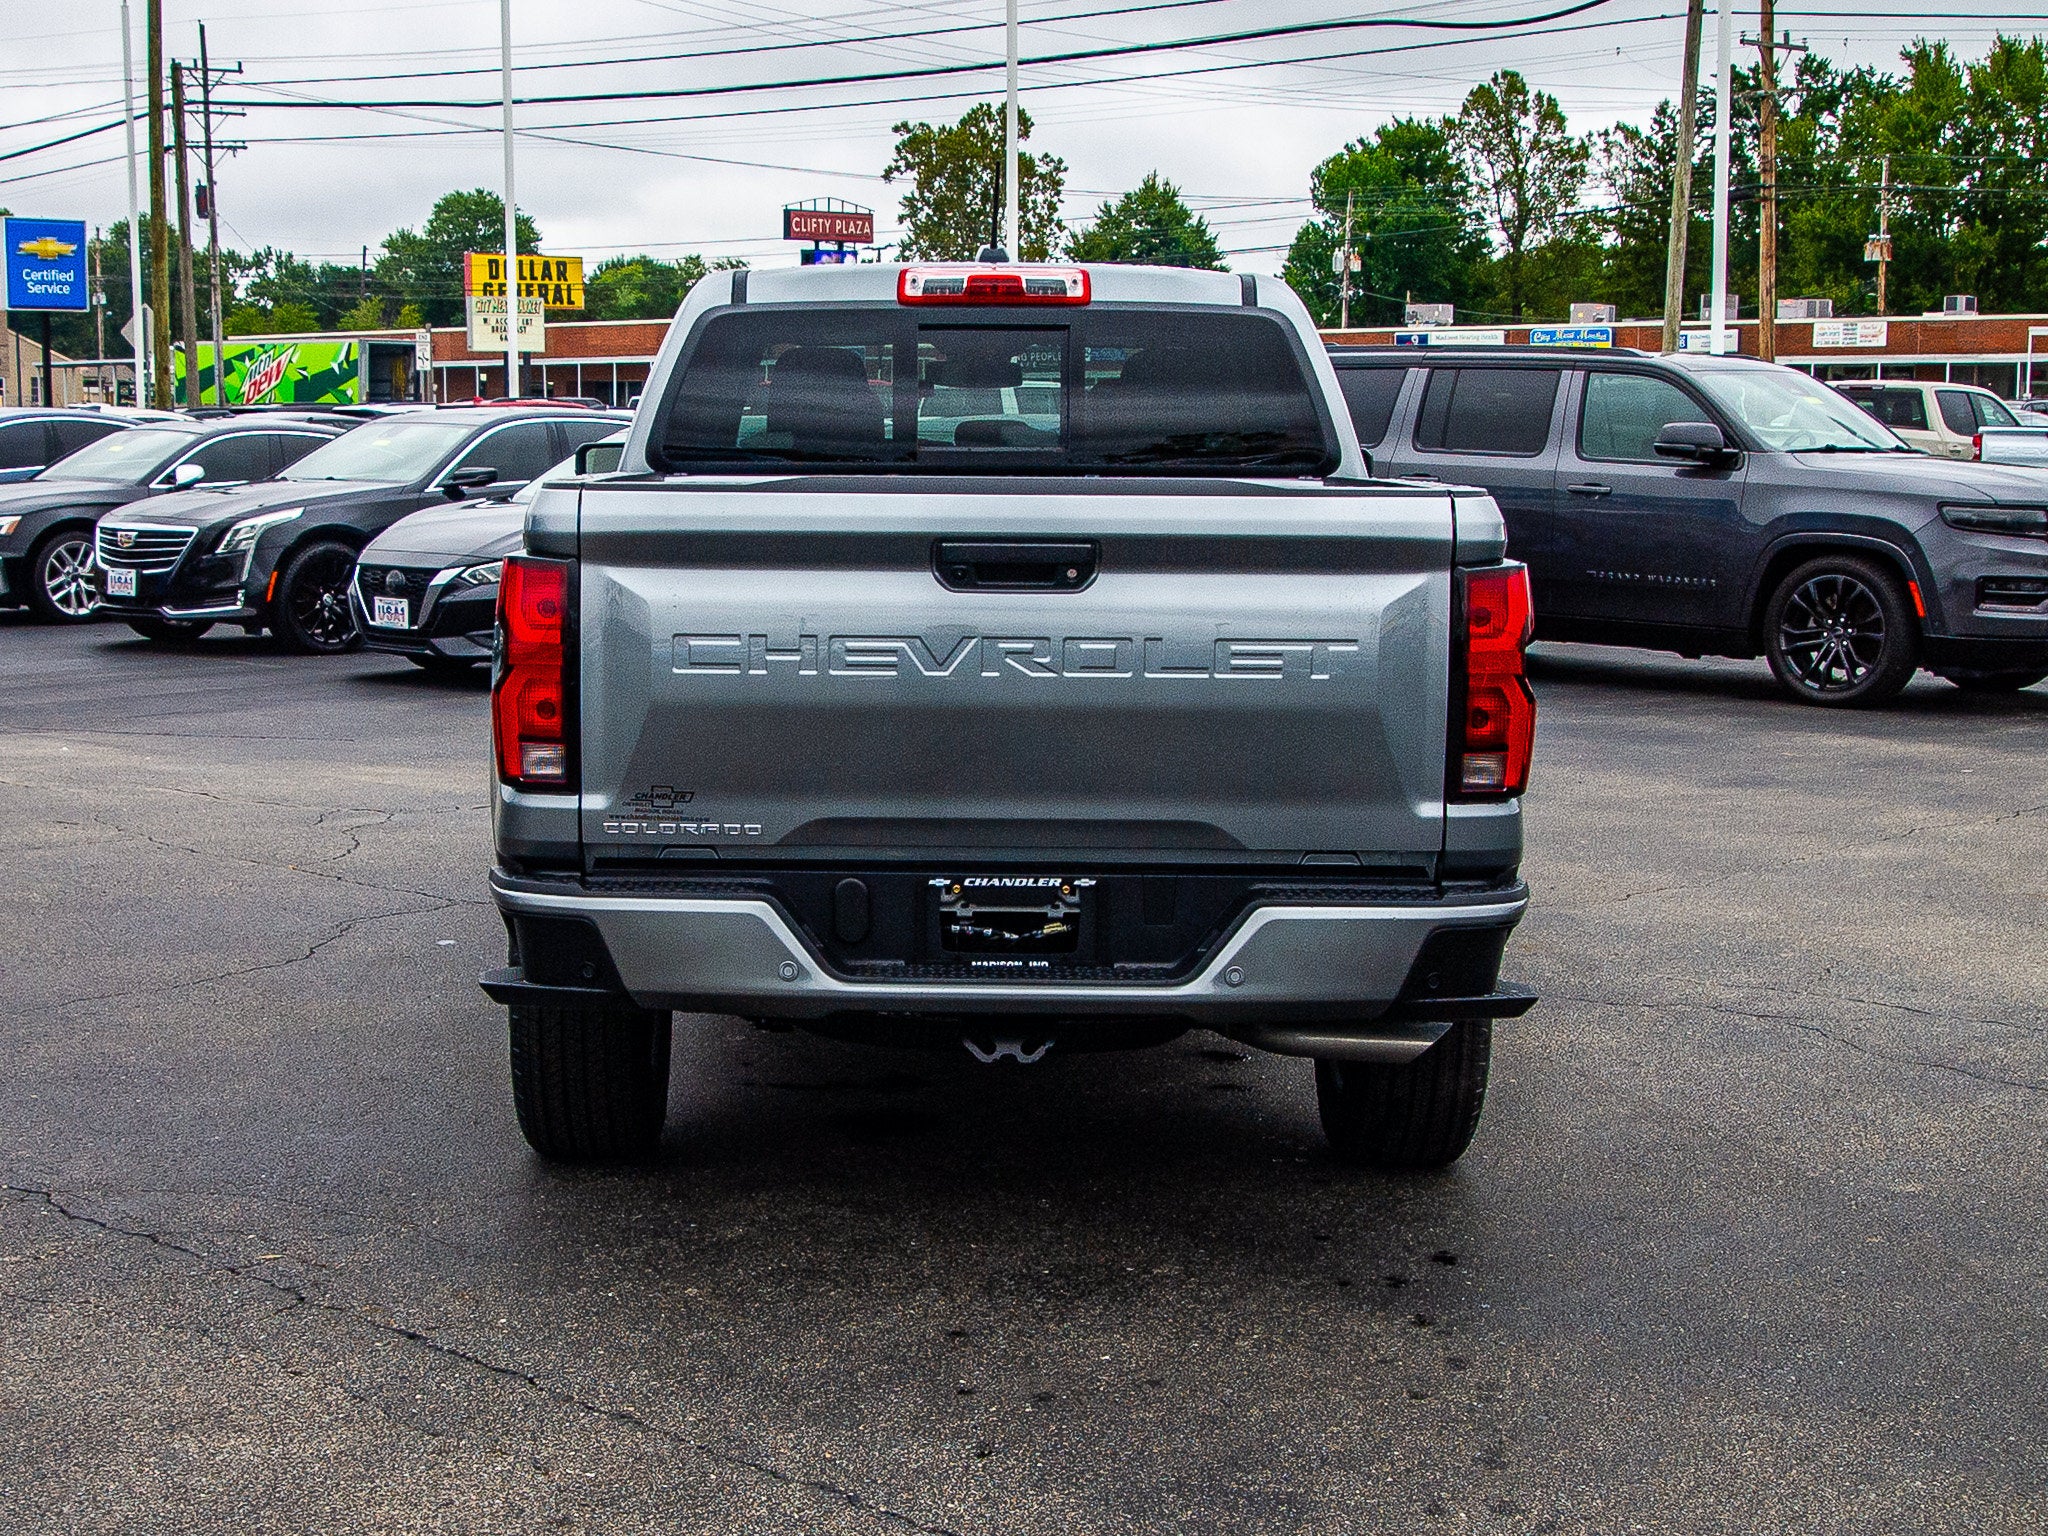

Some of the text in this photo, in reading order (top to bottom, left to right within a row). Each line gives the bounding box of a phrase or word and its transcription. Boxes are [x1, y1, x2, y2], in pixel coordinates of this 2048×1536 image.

[792, 216, 871, 236] CLIFTY PLAZA
[22, 268, 75, 282] Certified
[488, 259, 568, 282] DLLAR
[27, 281, 71, 294] Service
[671, 633, 1360, 680] CHEVROLET
[634, 791, 687, 801] CHANDLER
[602, 822, 762, 835] COLORADO
[963, 877, 1063, 887] CHANDLER
